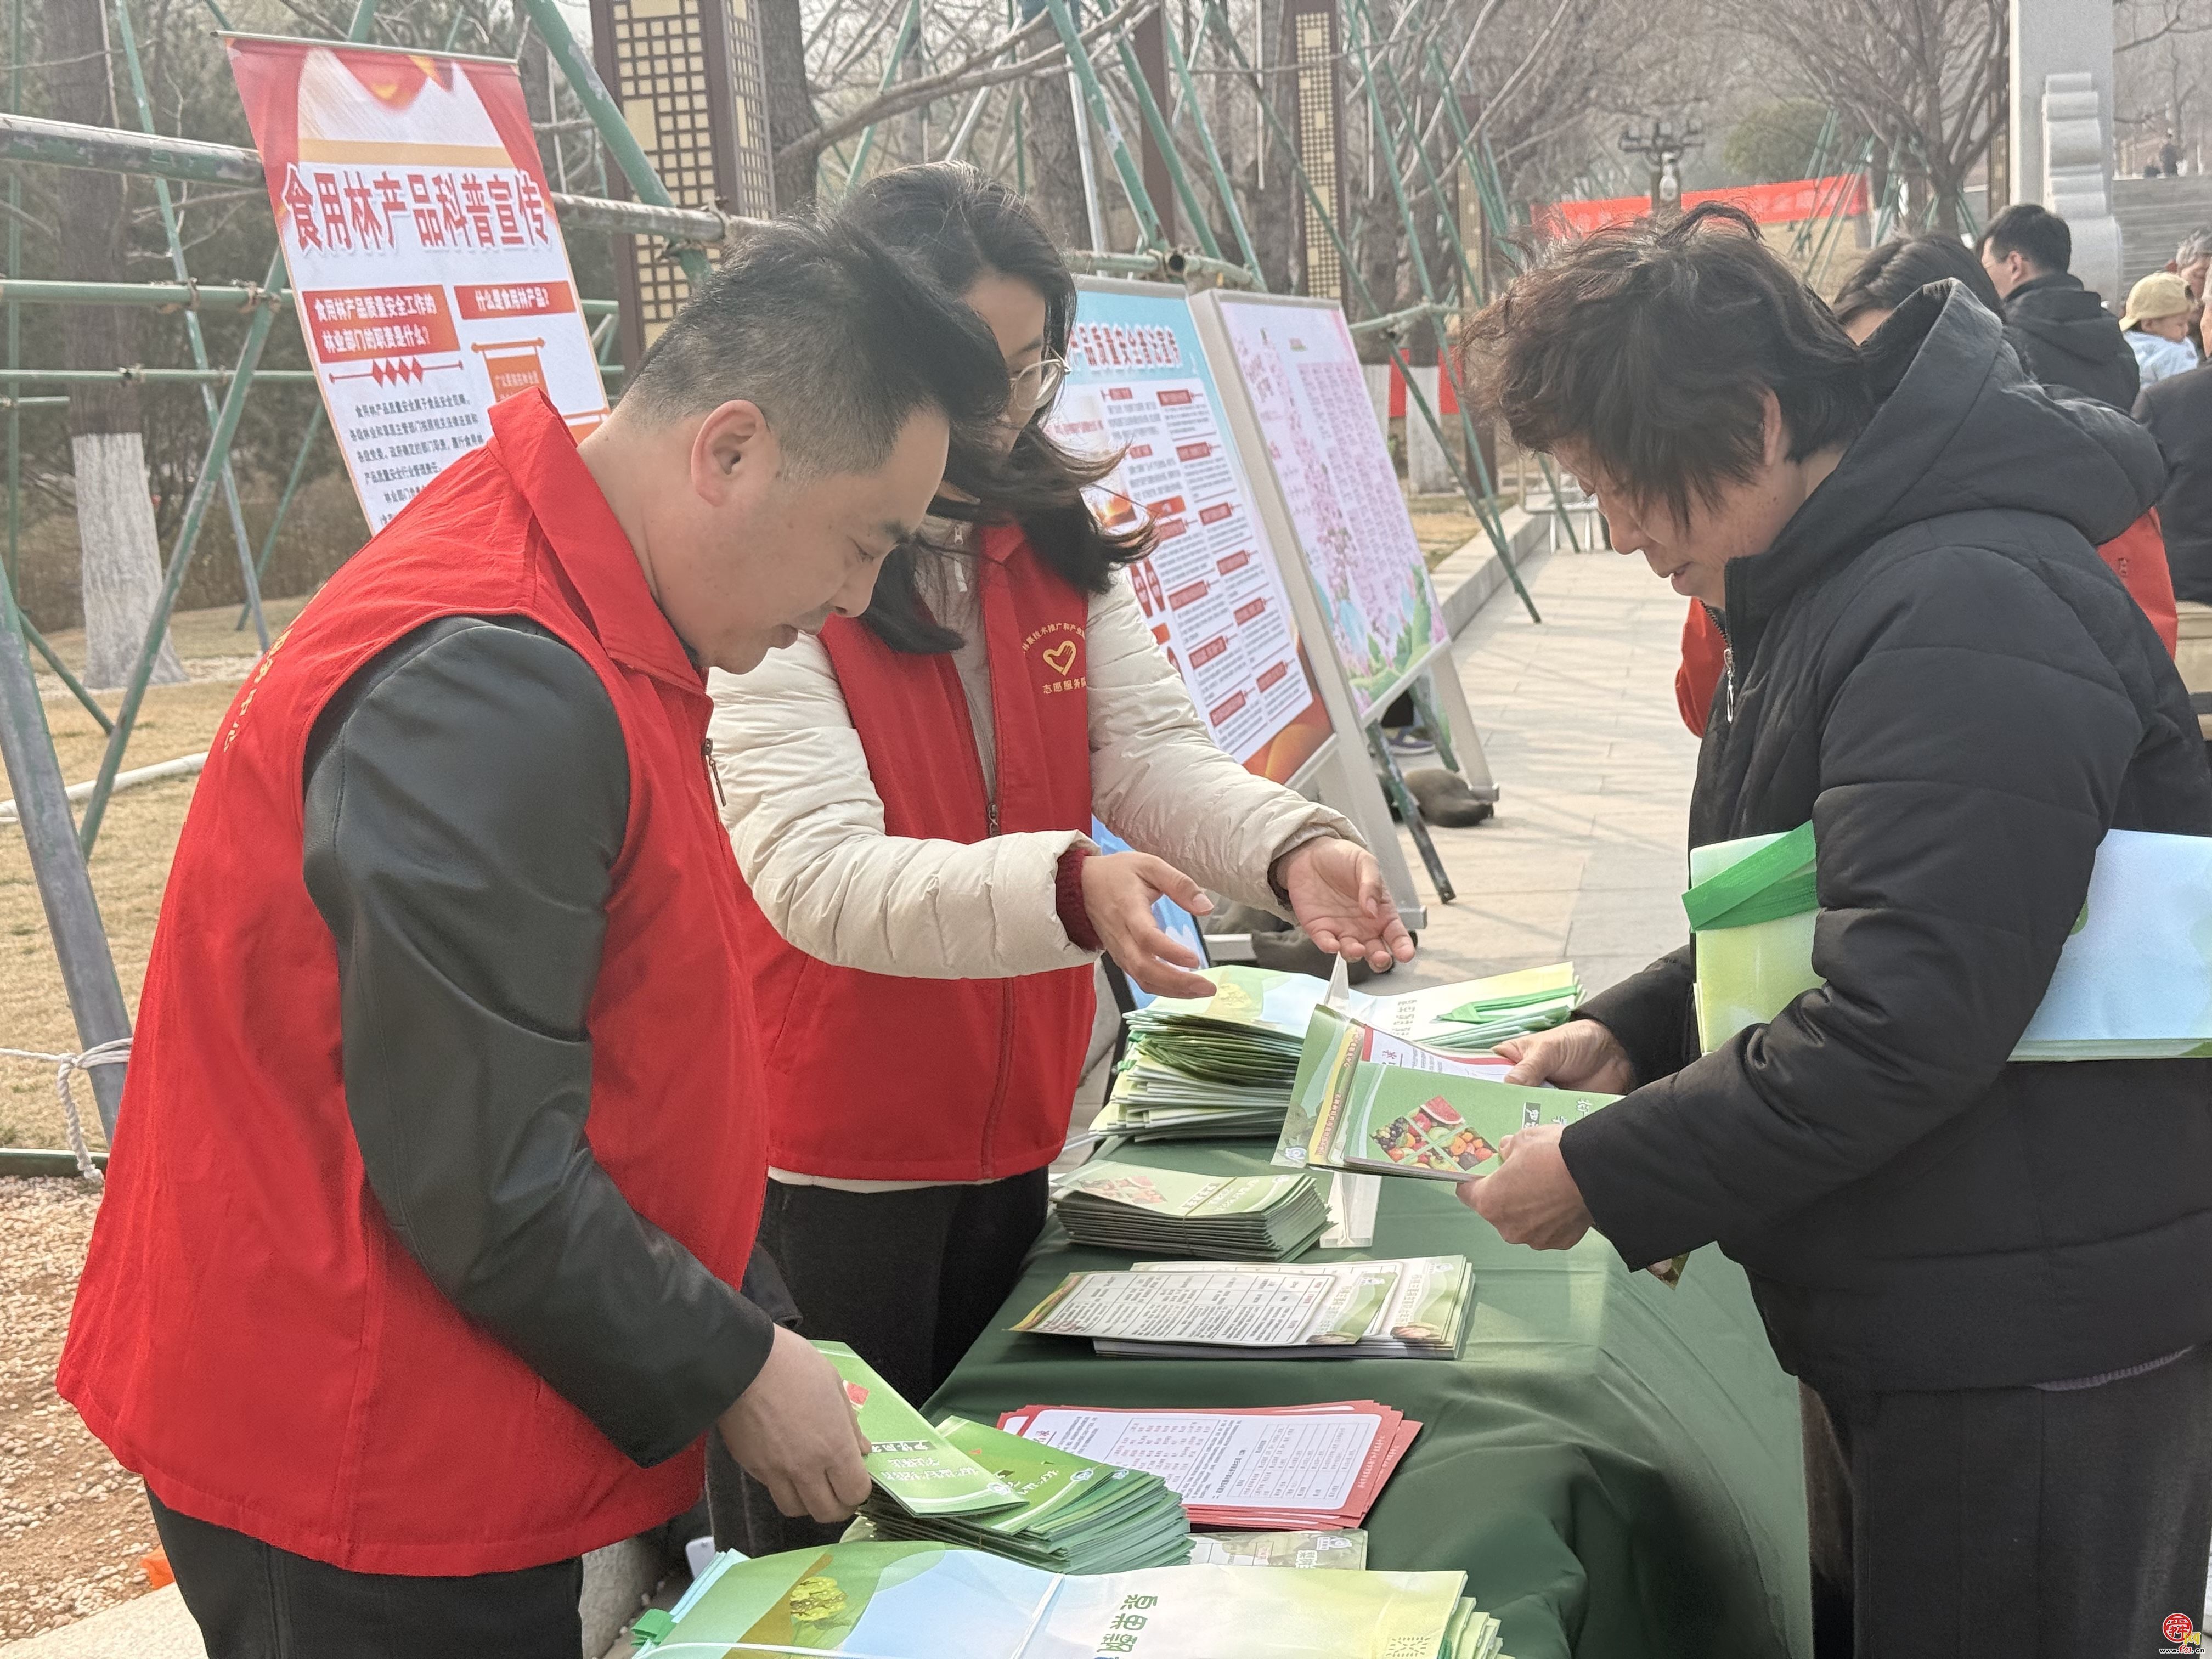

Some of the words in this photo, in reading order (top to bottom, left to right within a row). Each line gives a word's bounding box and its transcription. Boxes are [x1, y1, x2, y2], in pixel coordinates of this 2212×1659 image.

[283, 167, 549, 252] 食用林产品科普宣传
[1095, 1594, 1159, 1659] 泉果飘
